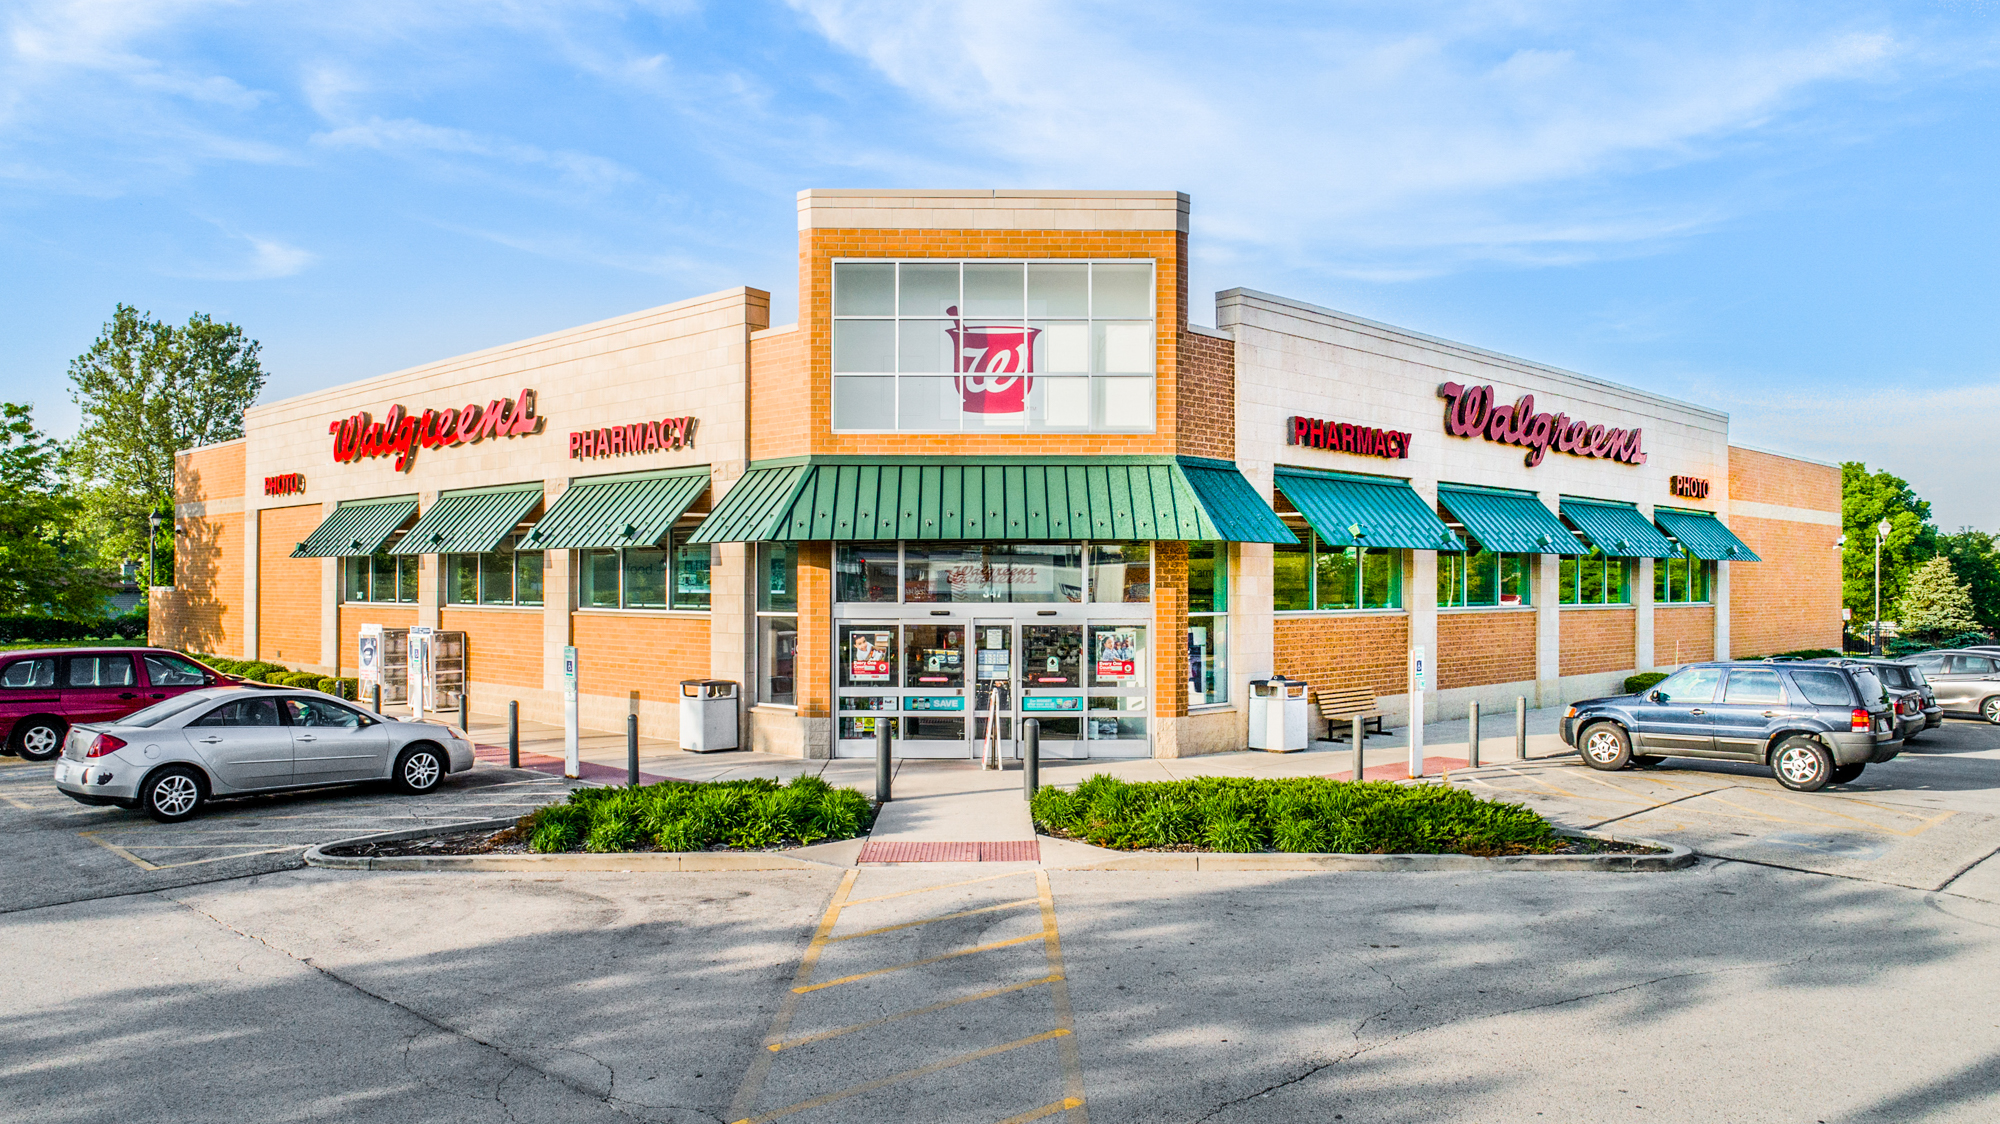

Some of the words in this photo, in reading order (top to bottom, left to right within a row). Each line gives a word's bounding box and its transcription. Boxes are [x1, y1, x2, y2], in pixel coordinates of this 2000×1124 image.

[329, 388, 538, 473] Walgreens
[569, 415, 692, 459] PHARMACY
[1293, 415, 1412, 459] PHARMACY
[1442, 381, 1648, 468] Walgreens
[264, 472, 299, 497] PHOTO
[1676, 475, 1710, 499] PHOTO
[983, 587, 1002, 598] 347
[933, 699, 959, 708] SAVE
